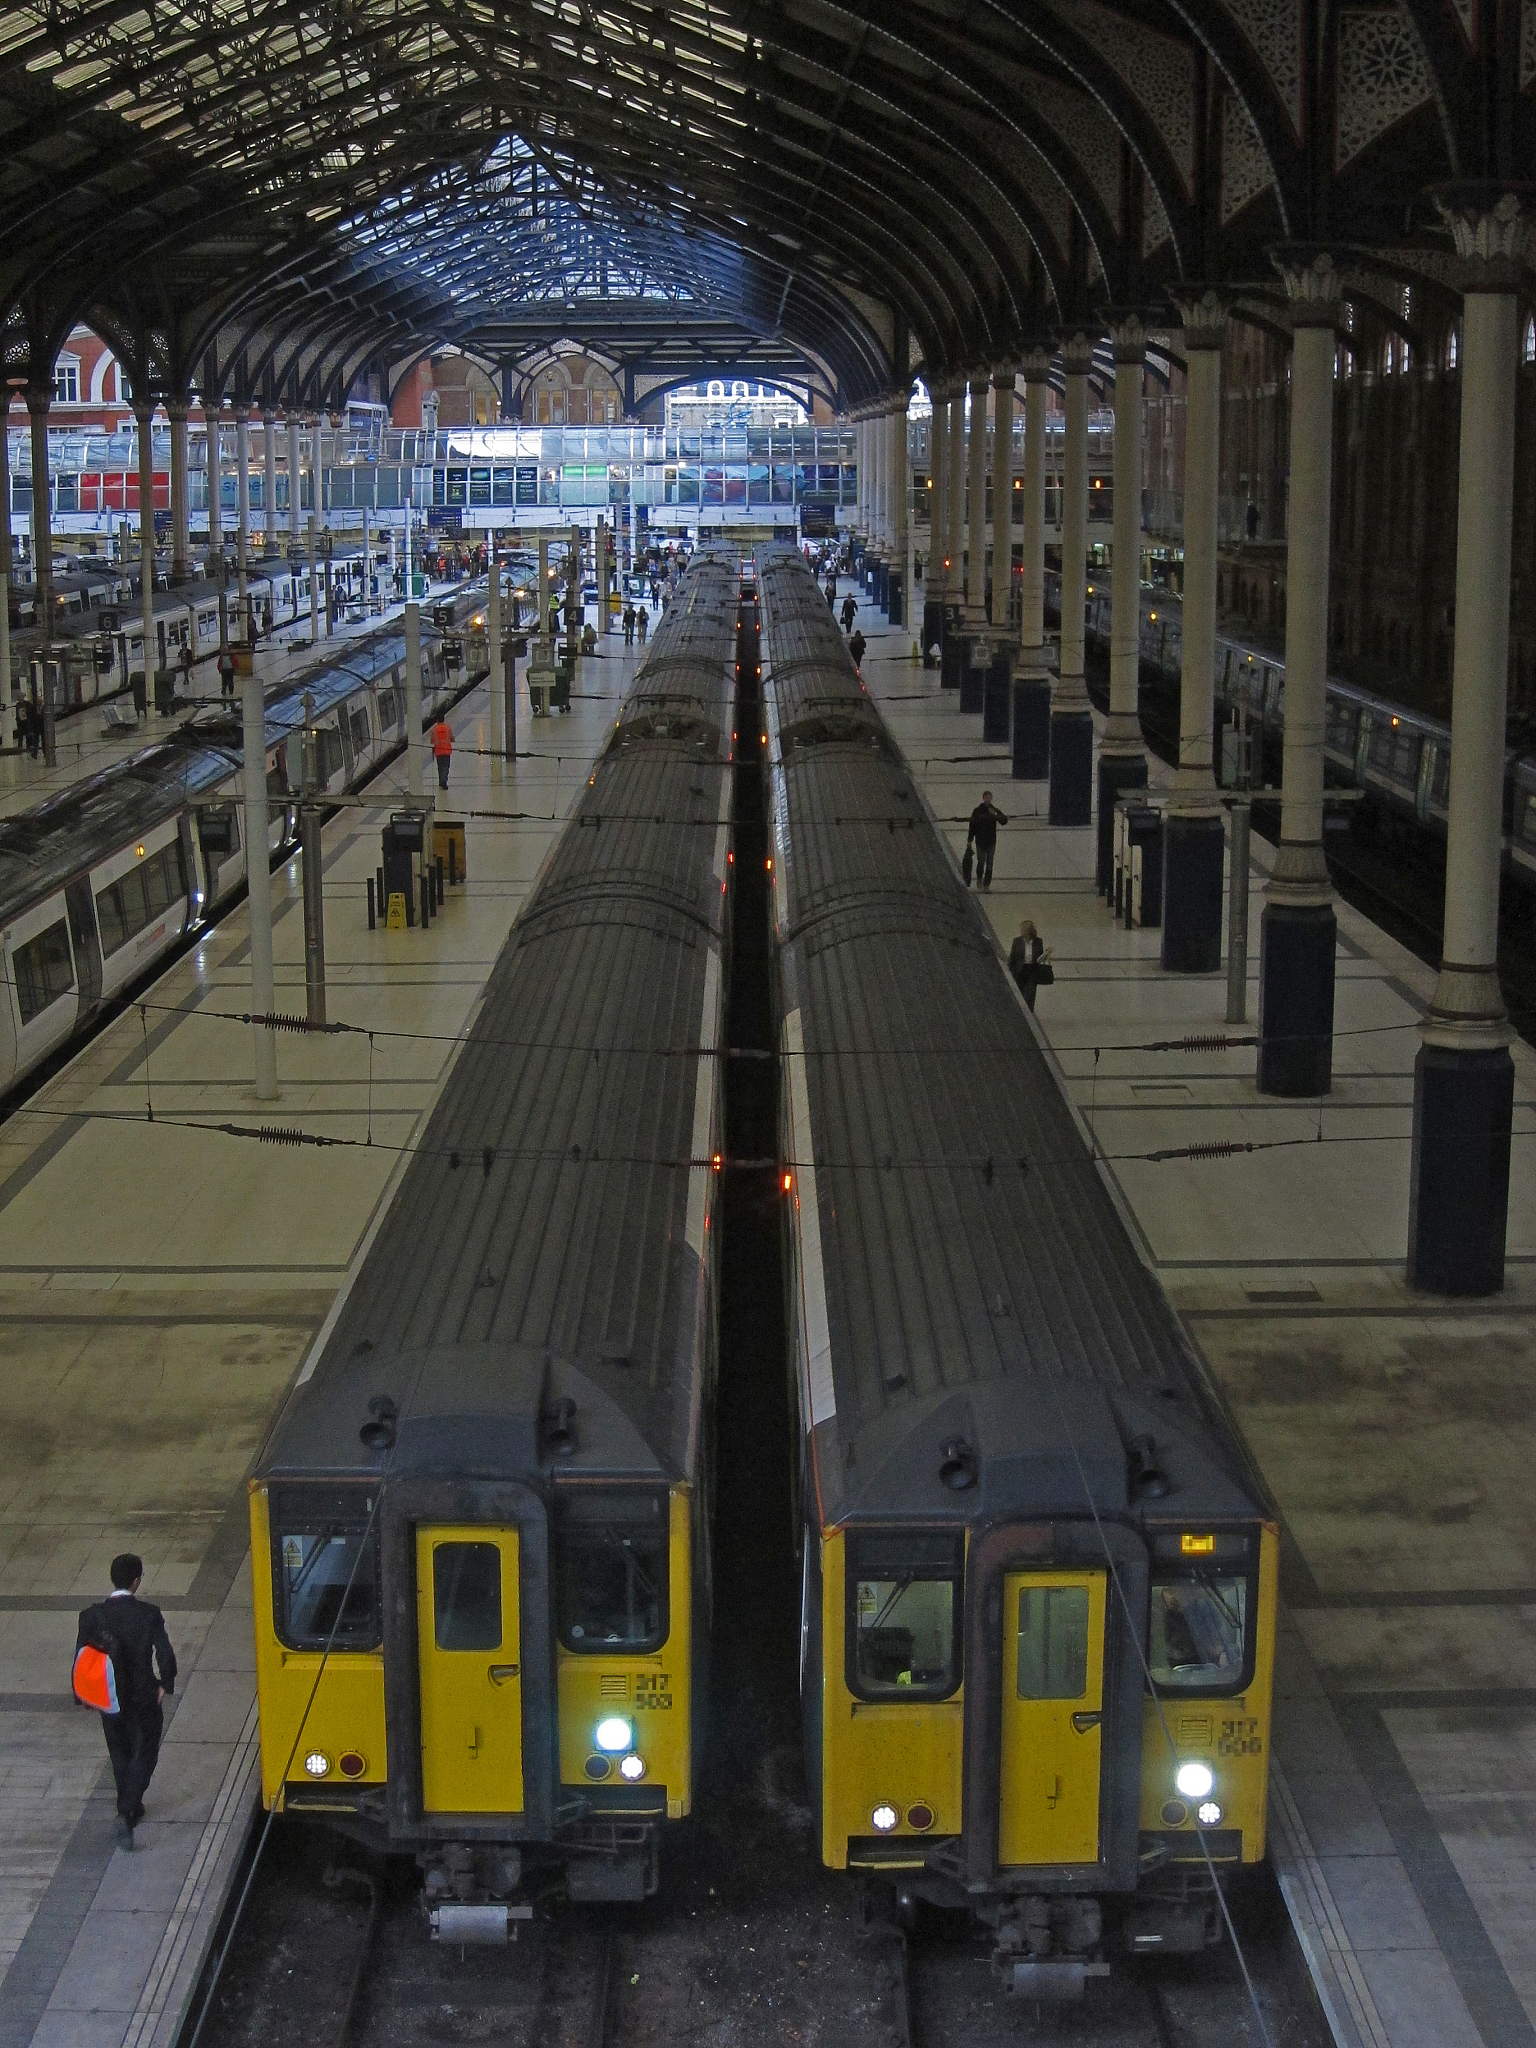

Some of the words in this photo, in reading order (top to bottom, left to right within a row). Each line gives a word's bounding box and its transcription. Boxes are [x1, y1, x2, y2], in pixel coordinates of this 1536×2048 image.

[438, 611, 447, 623] 5
[569, 611, 577, 623] 4
[946, 608, 954, 620] 3
[104, 616, 112, 628] 6
